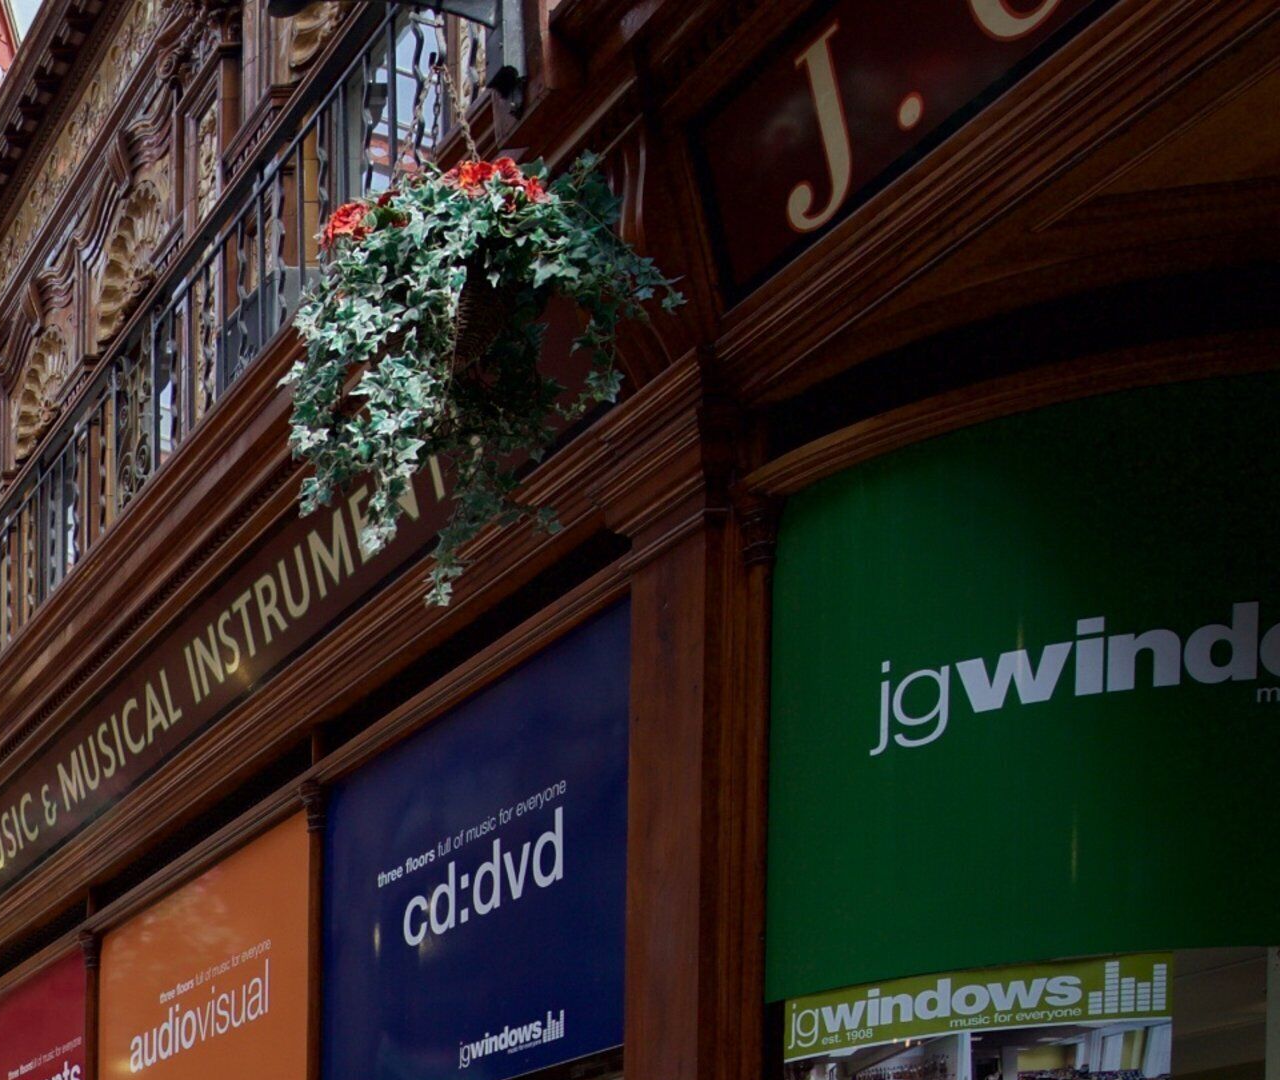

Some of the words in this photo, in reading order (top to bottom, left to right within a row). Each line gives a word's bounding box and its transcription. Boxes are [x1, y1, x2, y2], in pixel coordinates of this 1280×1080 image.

[43, 784, 59, 827] &
[57, 670, 183, 813] MUSICAL
[378, 865, 403, 888] three
[405, 849, 435, 874] floors
[437, 836, 451, 857] full
[453, 829, 464, 850] of
[466, 816, 497, 843] music
[499, 807, 513, 826] for
[515, 780, 567, 817] everyone
[402, 805, 564, 947] cd:dvd
[130, 958, 269, 1073] audiovisual
[458, 1020, 542, 1069] jgwindows
[788, 974, 1083, 1050] jgwindows
[821, 1032, 841, 1046] est.
[845, 1028, 873, 1042] 1908
[949, 1013, 990, 1028] music
[994, 1011, 1012, 1024] for
[1015, 1006, 1082, 1025] everyone
